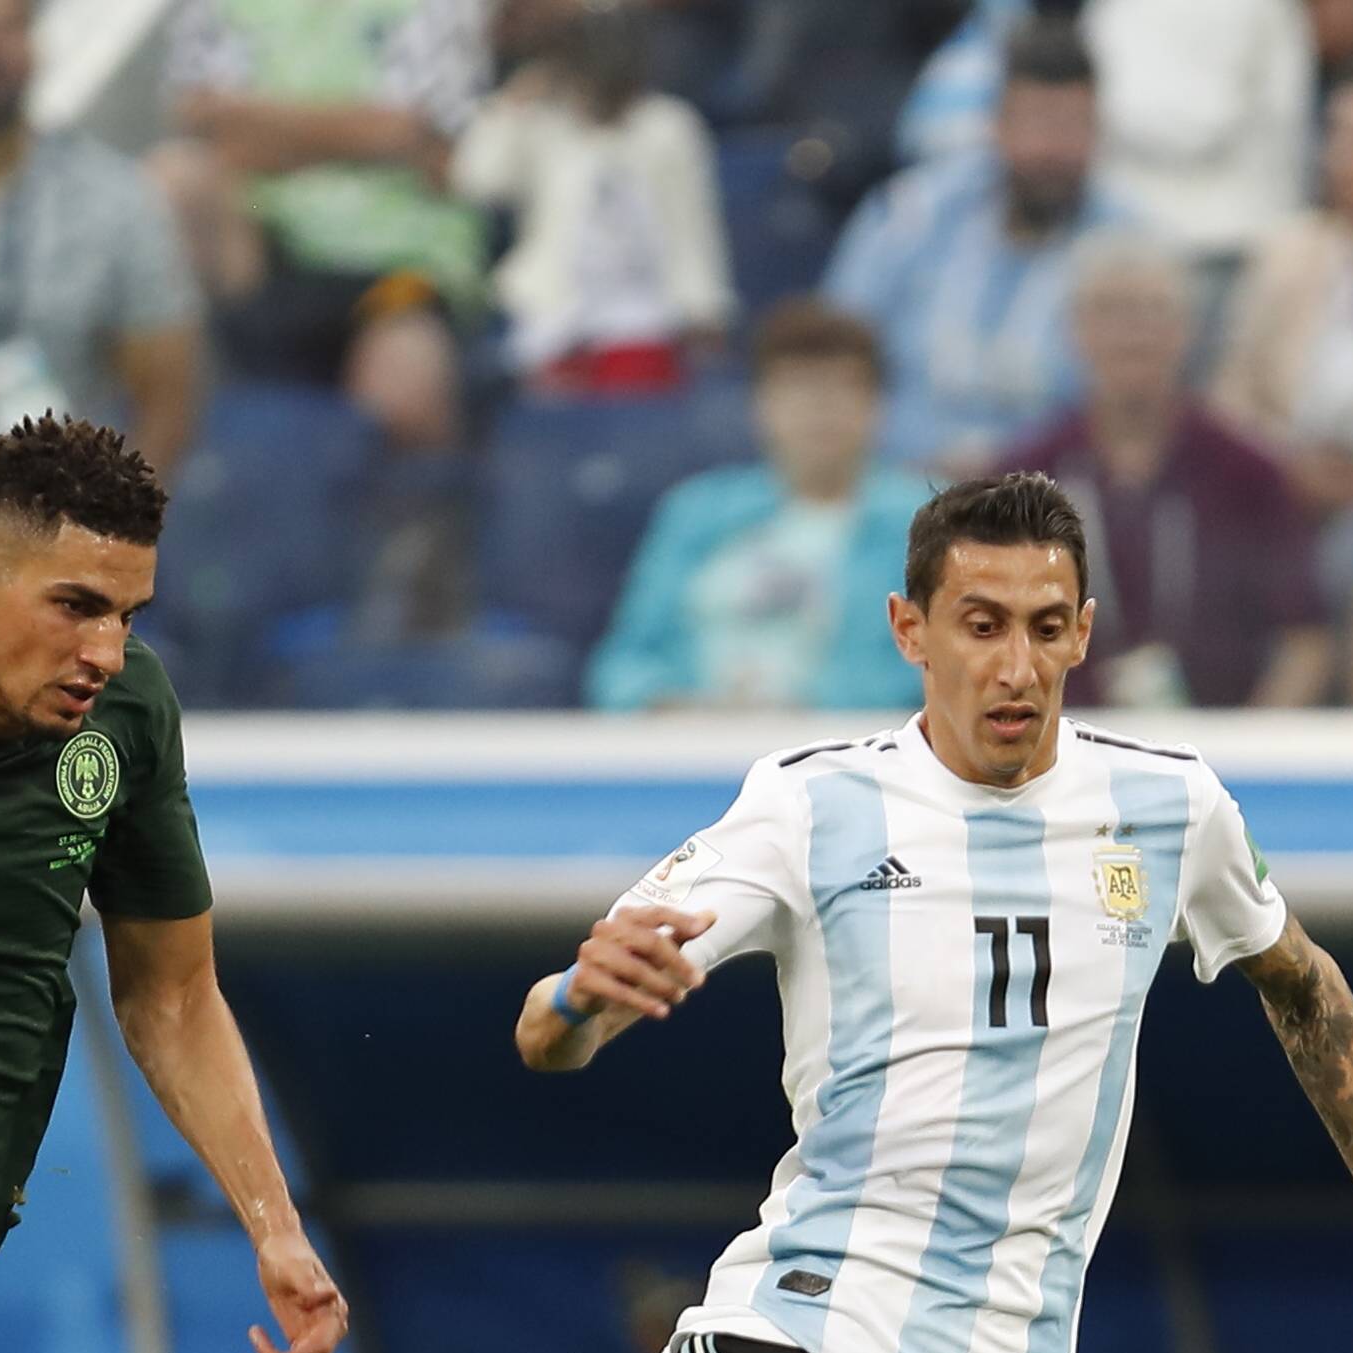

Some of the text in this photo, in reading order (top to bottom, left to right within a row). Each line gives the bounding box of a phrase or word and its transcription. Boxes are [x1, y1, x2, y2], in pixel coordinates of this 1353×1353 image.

[859, 874, 922, 891] adidas
[1109, 865, 1138, 900] AFA
[974, 916, 1052, 1029] 11
